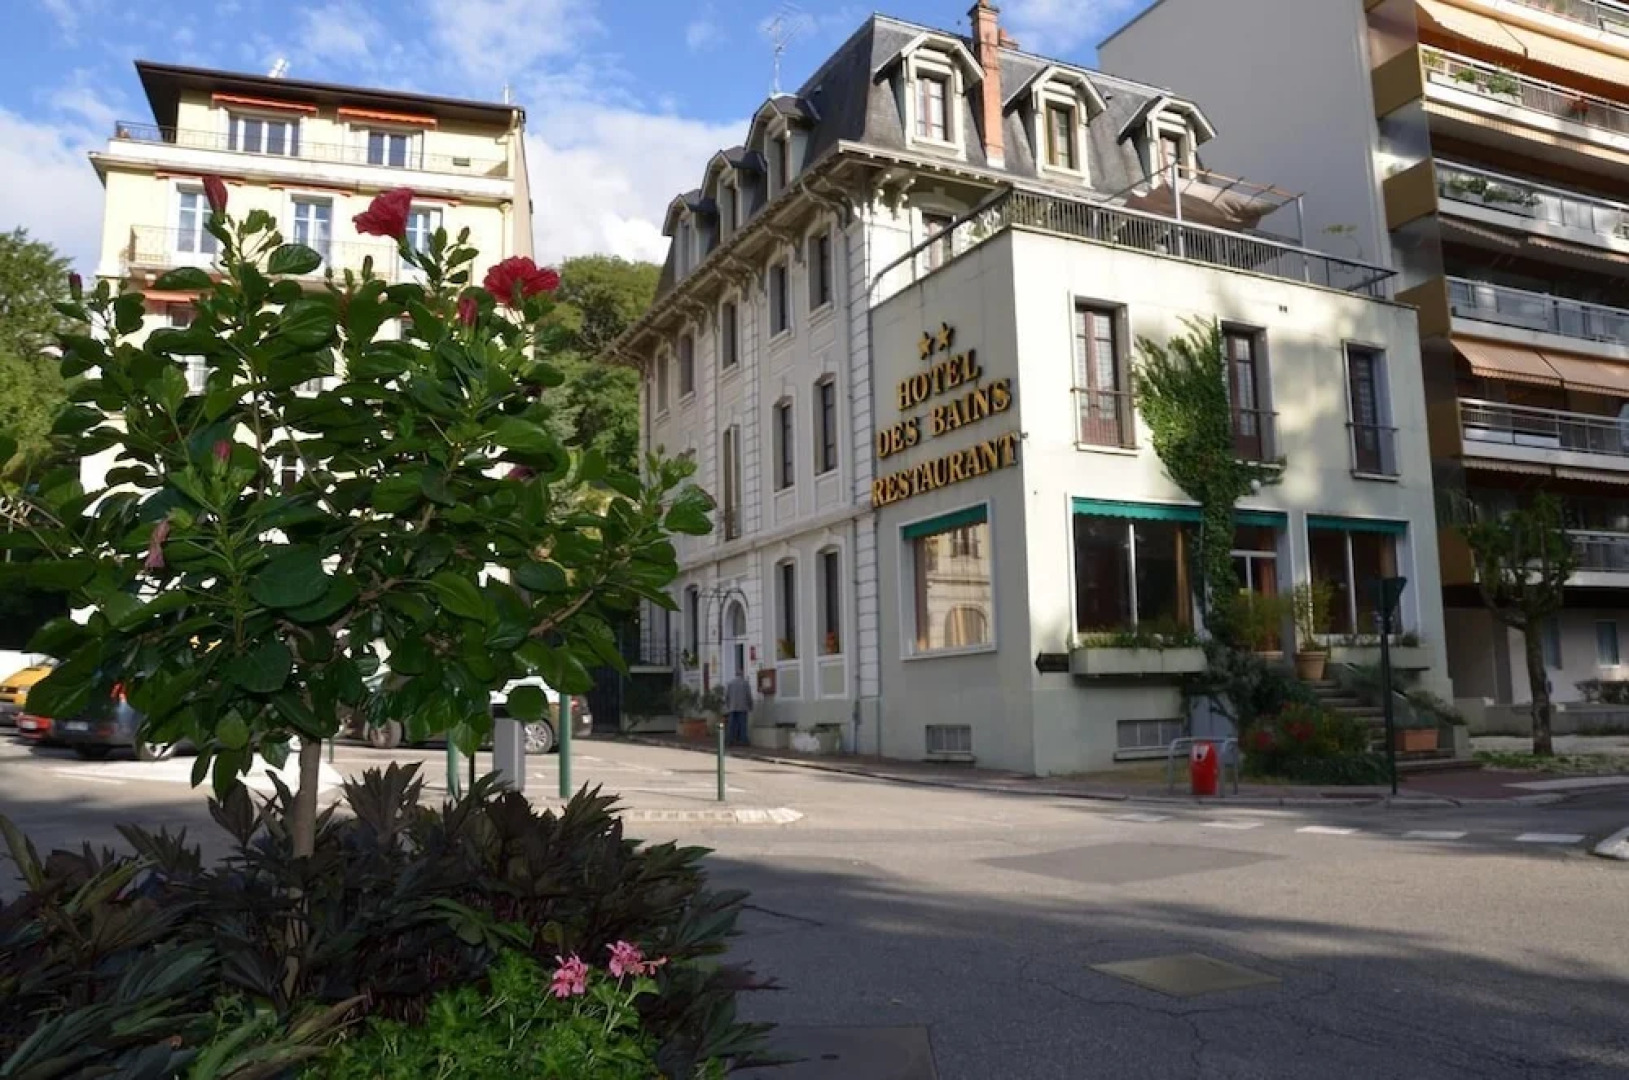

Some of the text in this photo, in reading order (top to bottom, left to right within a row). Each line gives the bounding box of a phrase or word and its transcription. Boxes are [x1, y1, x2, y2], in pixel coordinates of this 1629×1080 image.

[897, 349, 982, 410] HOTEL
[877, 378, 1011, 459] DES BAINS
[871, 431, 1019, 507] RESTAURANT
